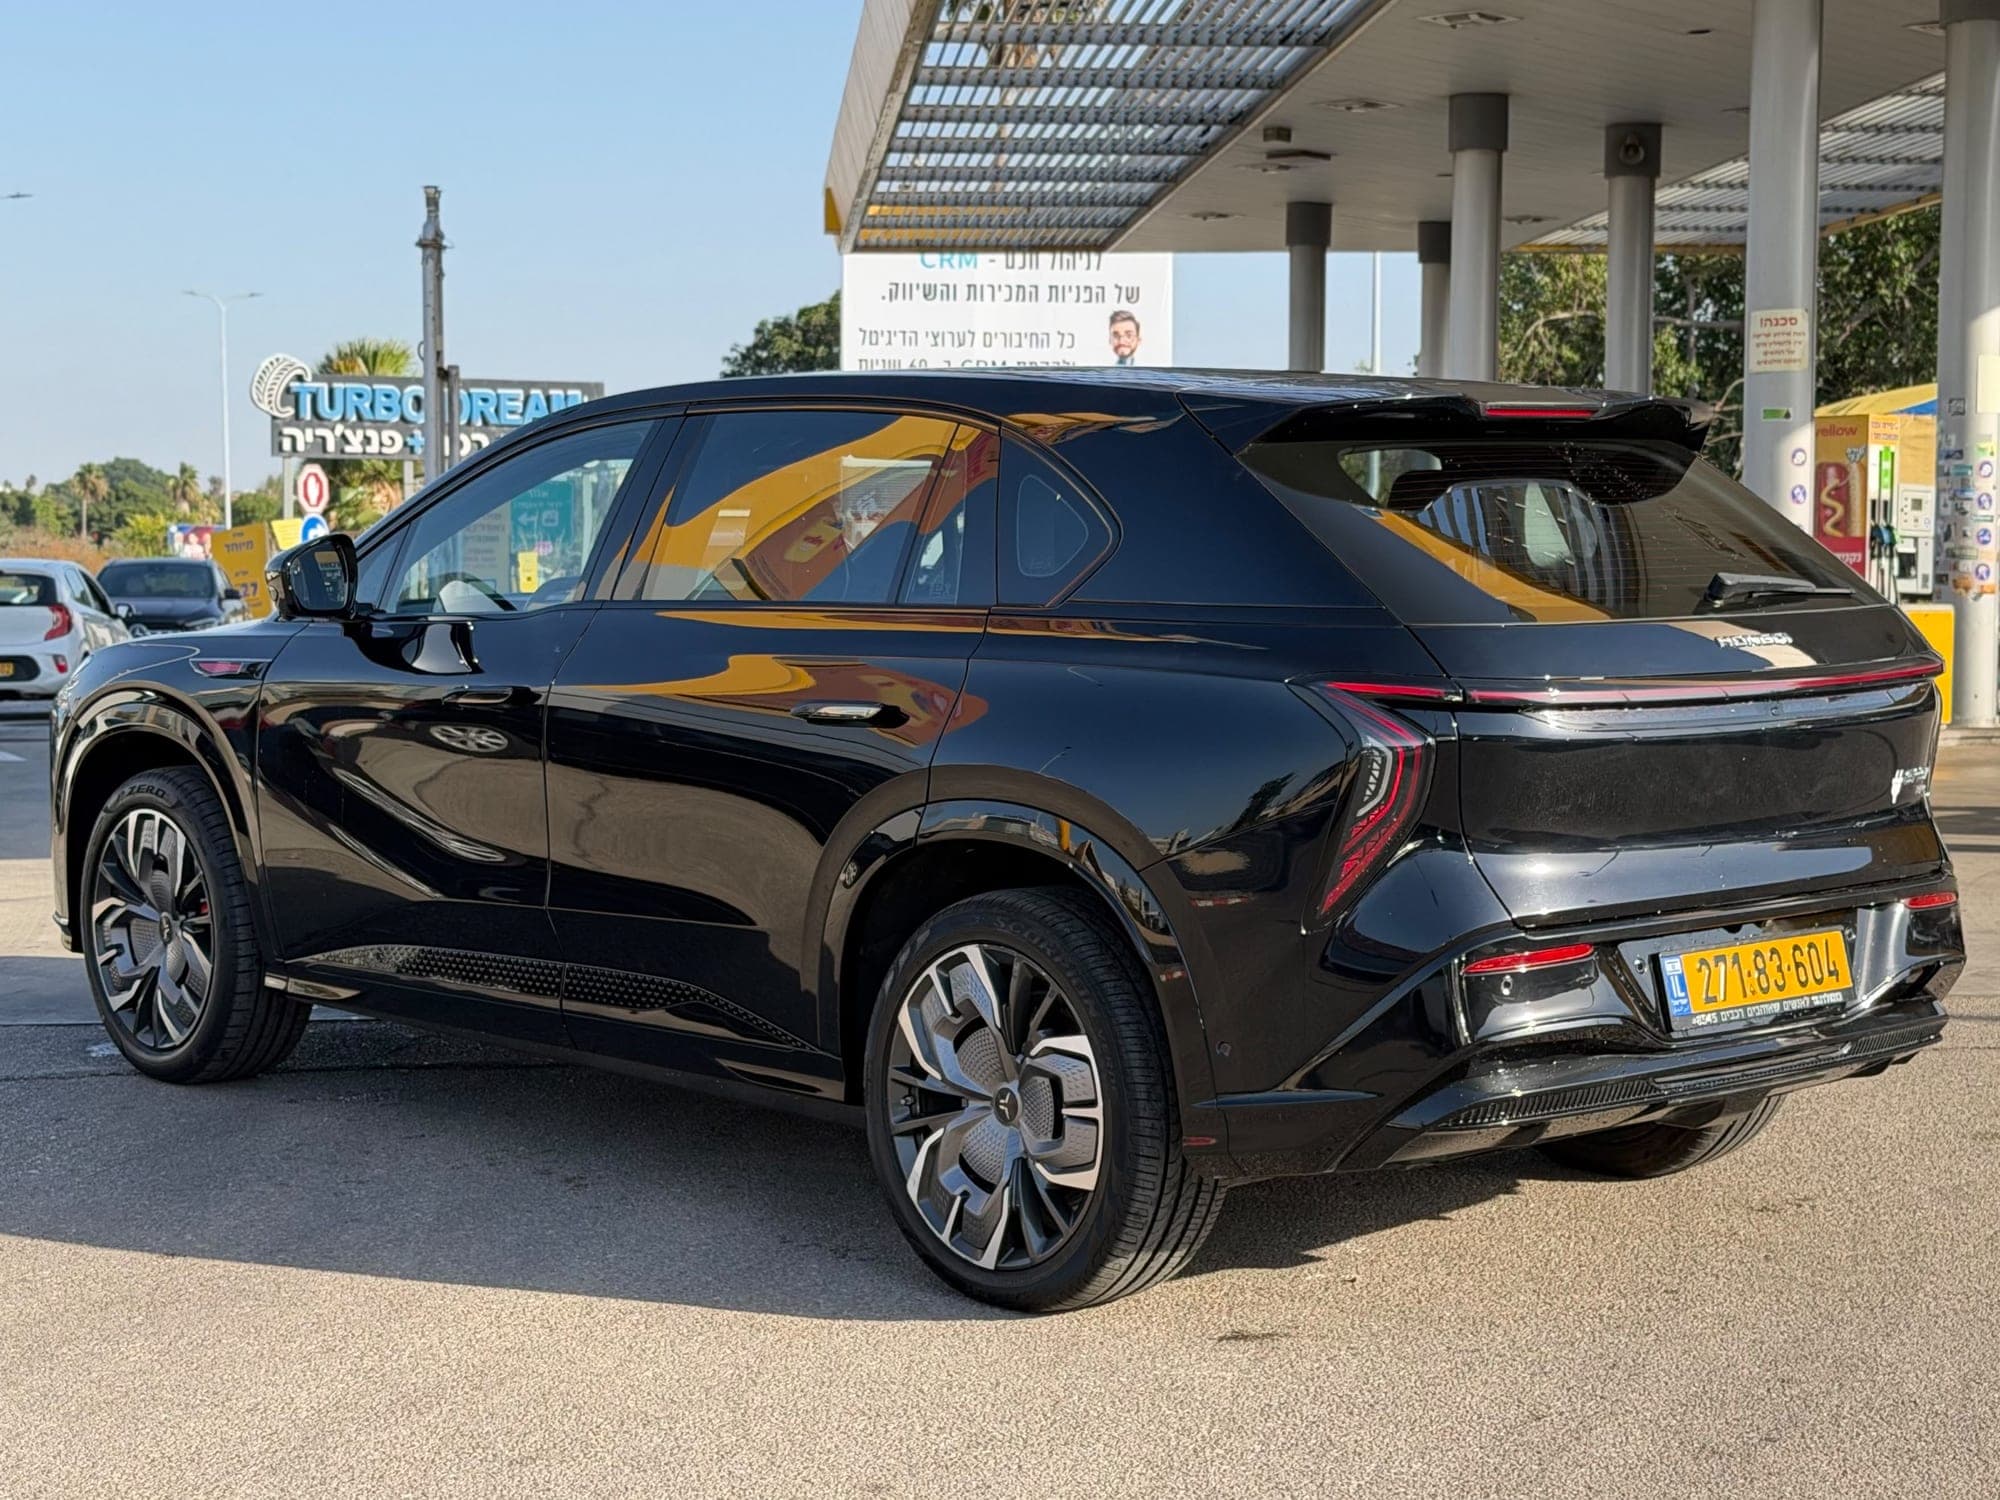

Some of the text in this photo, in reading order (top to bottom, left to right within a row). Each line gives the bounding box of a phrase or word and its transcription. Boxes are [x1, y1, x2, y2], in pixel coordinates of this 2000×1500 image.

[919, 252, 978, 269] CRM
[880, 281, 1140, 304] של הפניות המכירות והשיווק.
[858, 327, 1075, 349] כל החיבורים לערוצי הדיגיטל
[289, 381, 425, 424] TURBO
[280, 423, 404, 454] פנצ'ריה
[126, 784, 167, 798] ZERO
[1670, 974, 1686, 999] IL
